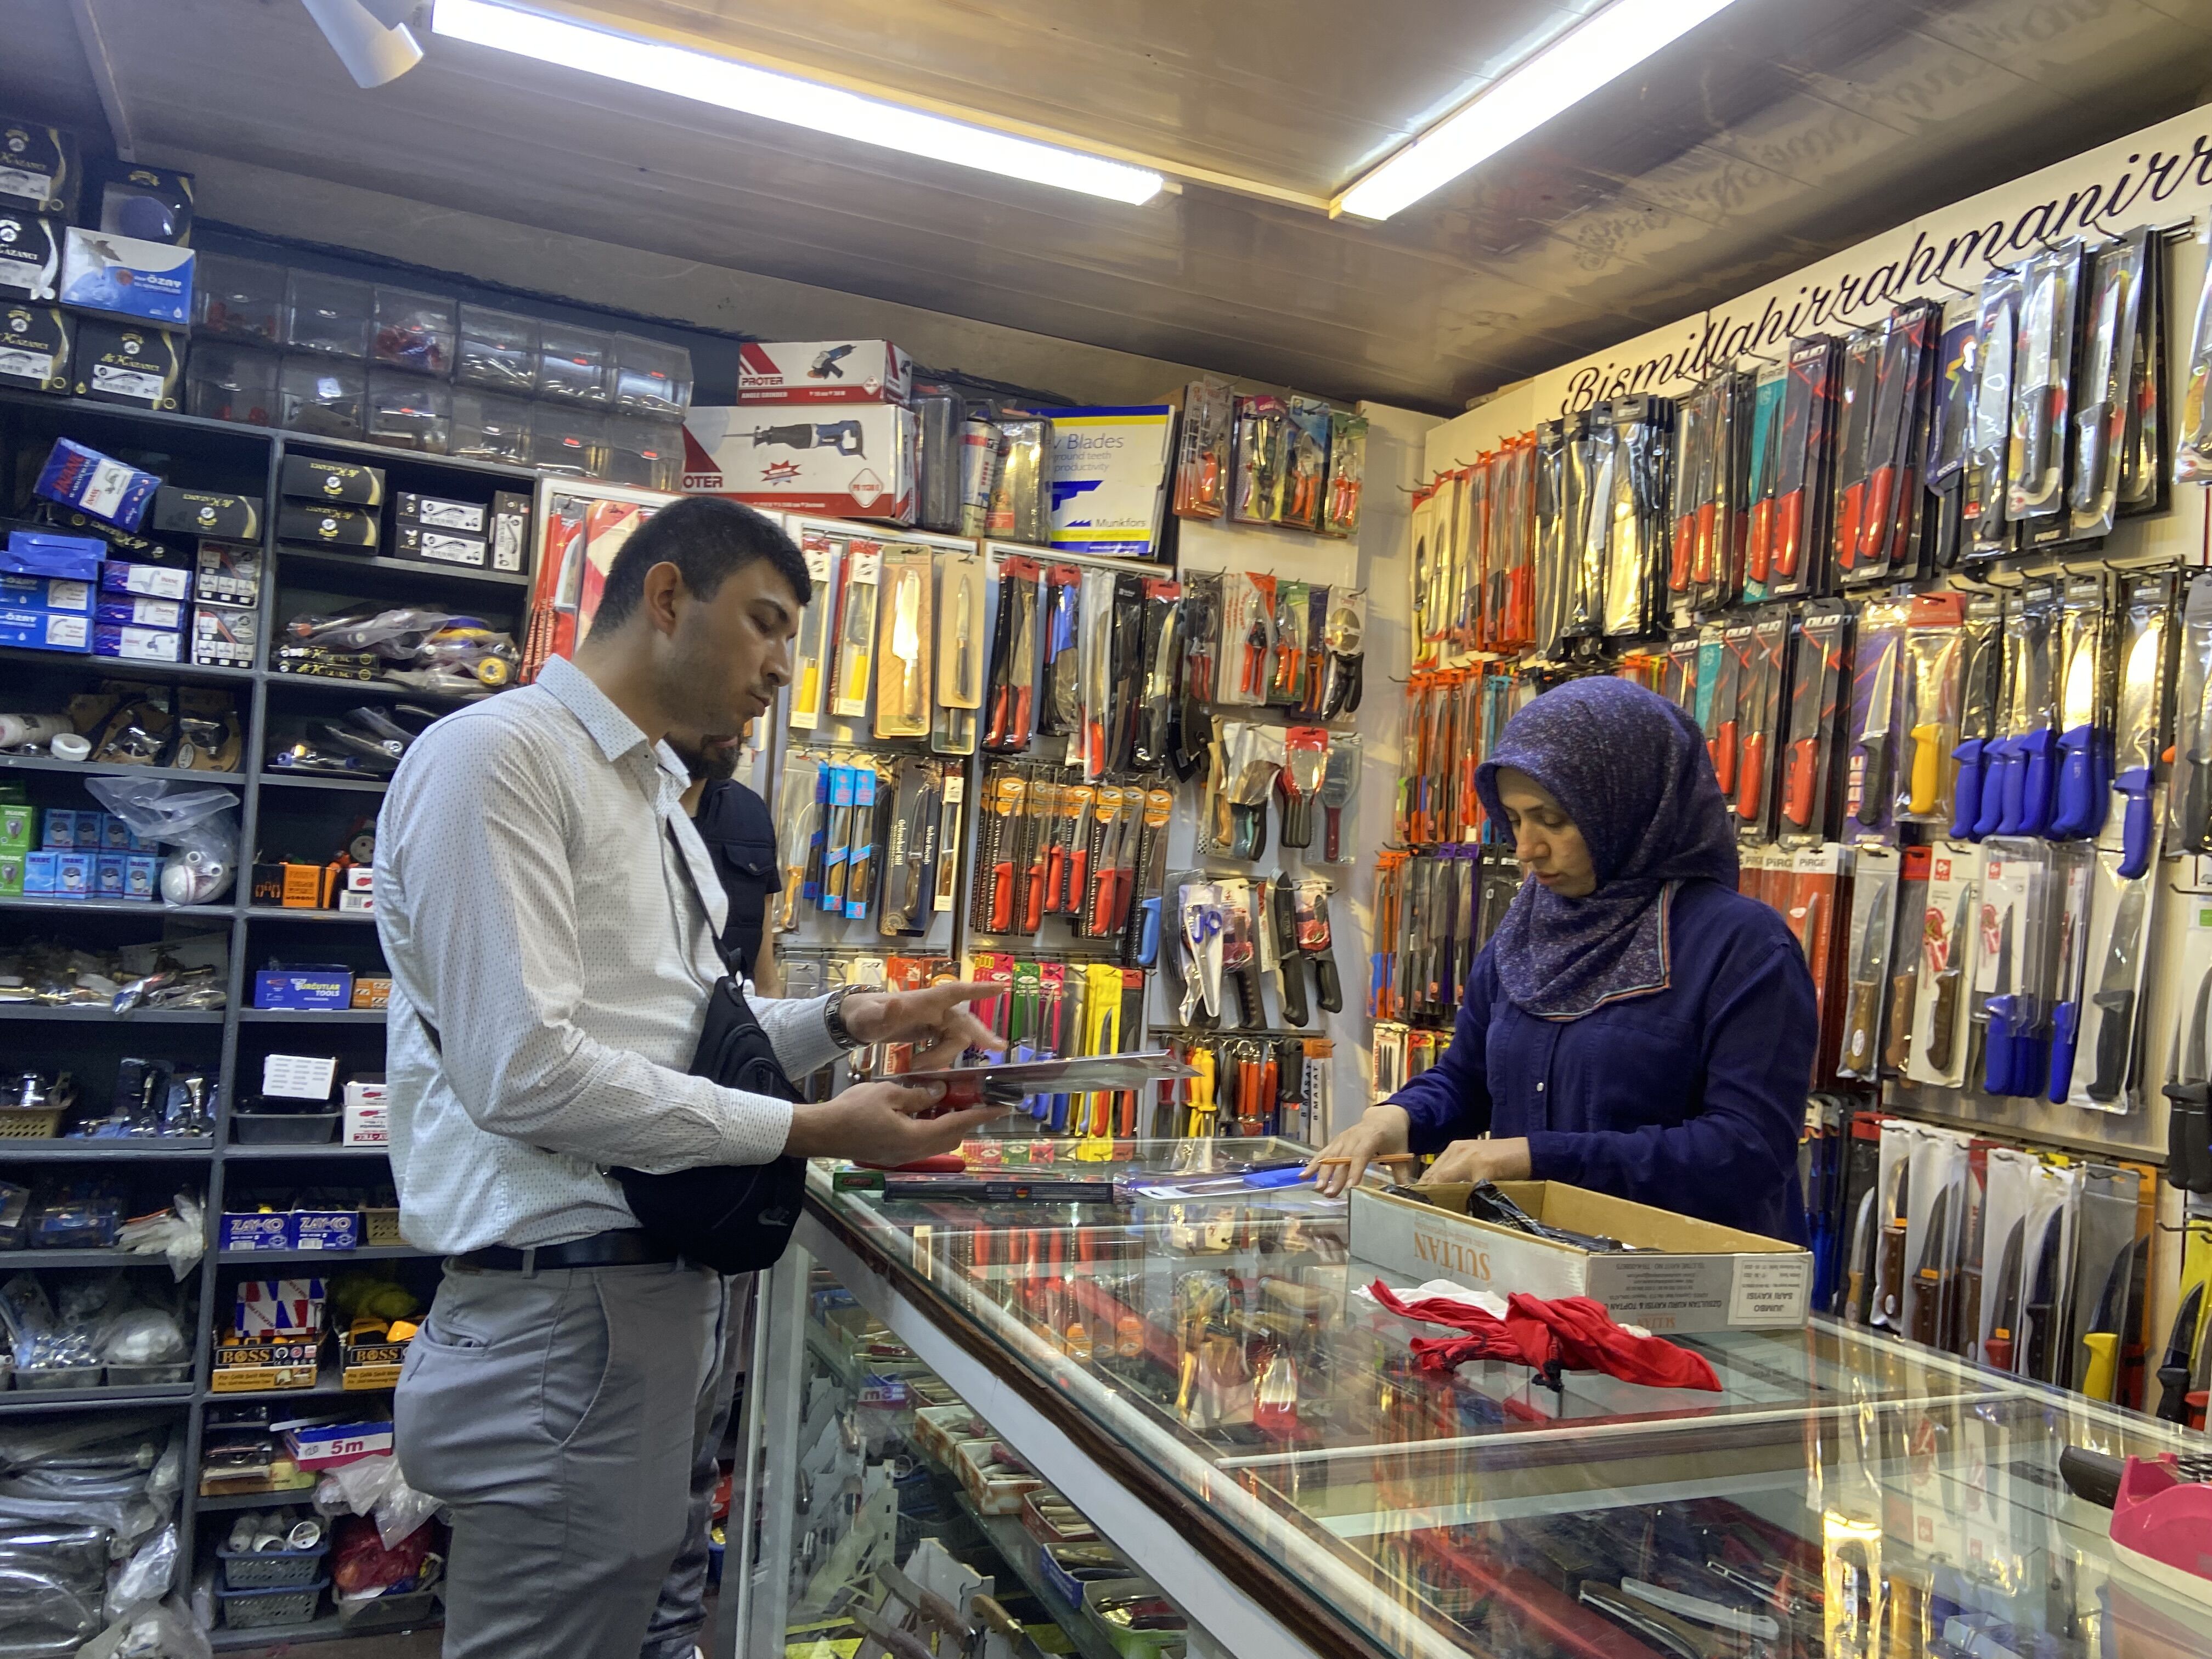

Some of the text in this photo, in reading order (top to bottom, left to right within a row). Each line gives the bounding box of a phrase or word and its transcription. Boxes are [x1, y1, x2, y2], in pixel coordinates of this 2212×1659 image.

[1792, 343, 1826, 361] DUO
[741, 377, 783, 386] PROTER
[1067, 433, 1124, 449] Blades
[1087, 452, 1111, 460] teeth
[1054, 463, 1109, 473] productivity
[683, 475, 723, 488] OTER
[1095, 518, 1146, 527] Munkfors
[1756, 619, 1782, 633] DUO
[1804, 614, 1842, 628] DUO
[1726, 626, 1752, 638] DUO
[1671, 640, 1699, 653] DUO
[1766, 857, 1792, 867] PiRG
[1302, 1063, 1311, 1106] MASAT
[1413, 1232, 1491, 1282] SULTAN
[1746, 1291, 1793, 1301] SARI KAYISI
[1753, 1304, 1784, 1313] JUMBO
[1637, 1316, 1677, 1330] SULTAN
[222, 1349, 270, 1363] BOSS
[356, 1347, 399, 1362] BOSS
[331, 1440, 364, 1454] 5m
